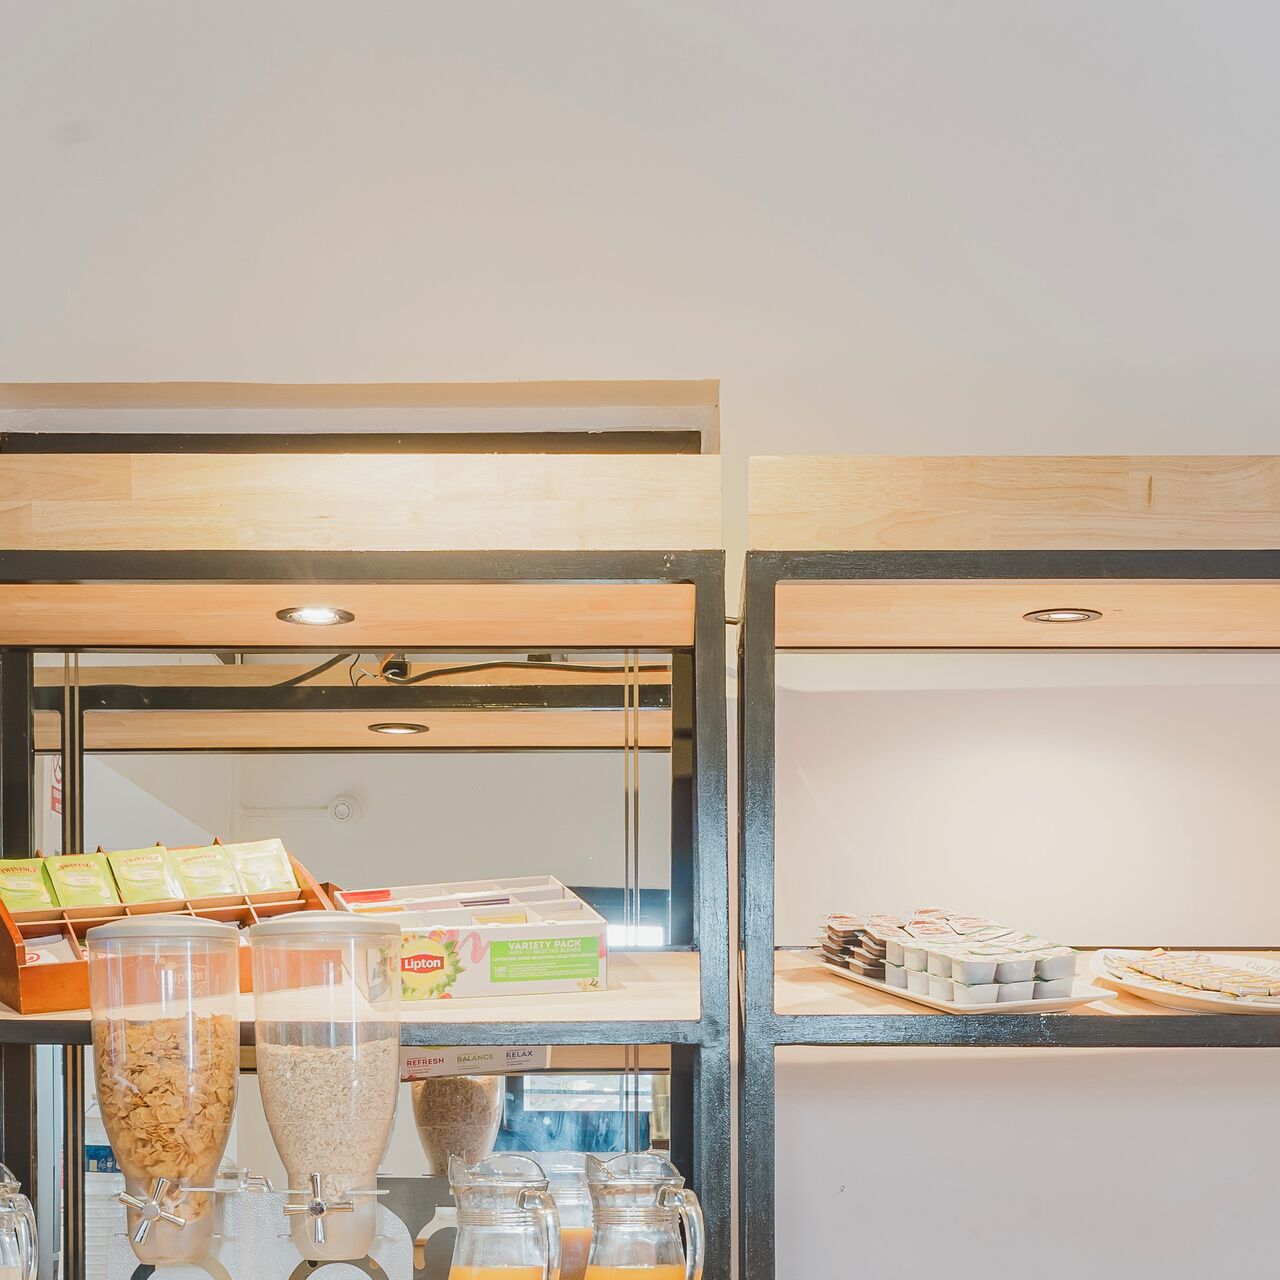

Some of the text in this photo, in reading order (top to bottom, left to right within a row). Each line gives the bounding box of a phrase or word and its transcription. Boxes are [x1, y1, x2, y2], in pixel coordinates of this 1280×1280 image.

[508, 939, 582, 951] VARIETY PACK
[404, 956, 441, 971] Lipton
[457, 1053, 494, 1063] BALANCE
[505, 1050, 533, 1059] RELAX
[406, 1057, 445, 1067] REFRESH
